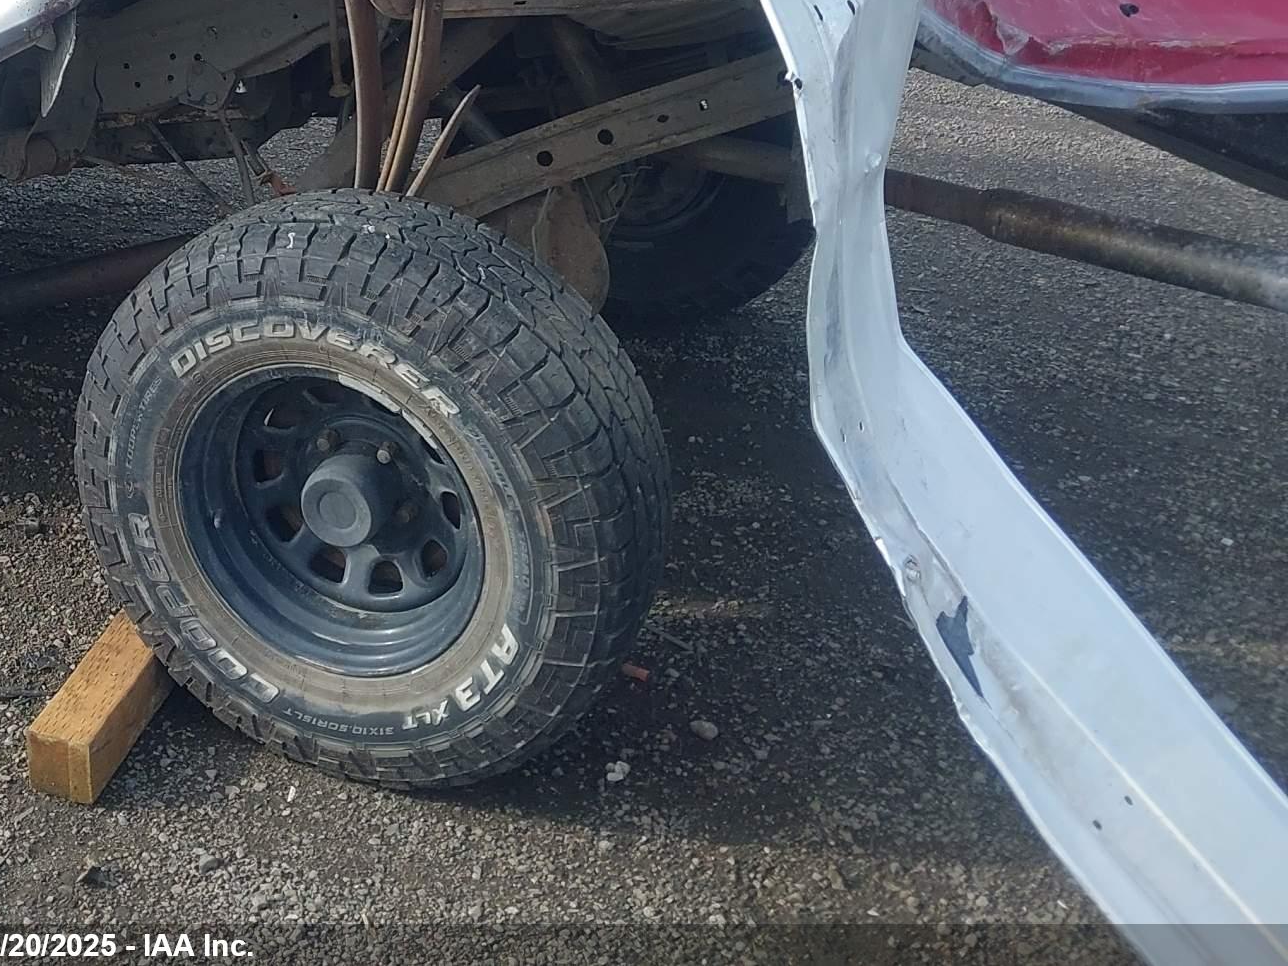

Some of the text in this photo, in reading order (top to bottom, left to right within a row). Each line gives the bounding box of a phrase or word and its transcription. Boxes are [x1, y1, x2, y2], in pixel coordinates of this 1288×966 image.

[169, 316, 460, 418] DISCOVERER
[127, 513, 280, 703] COOPER
[281, 707, 394, 736] 31X10.50R15LT
[402, 623, 520, 731] AT3 XLT
